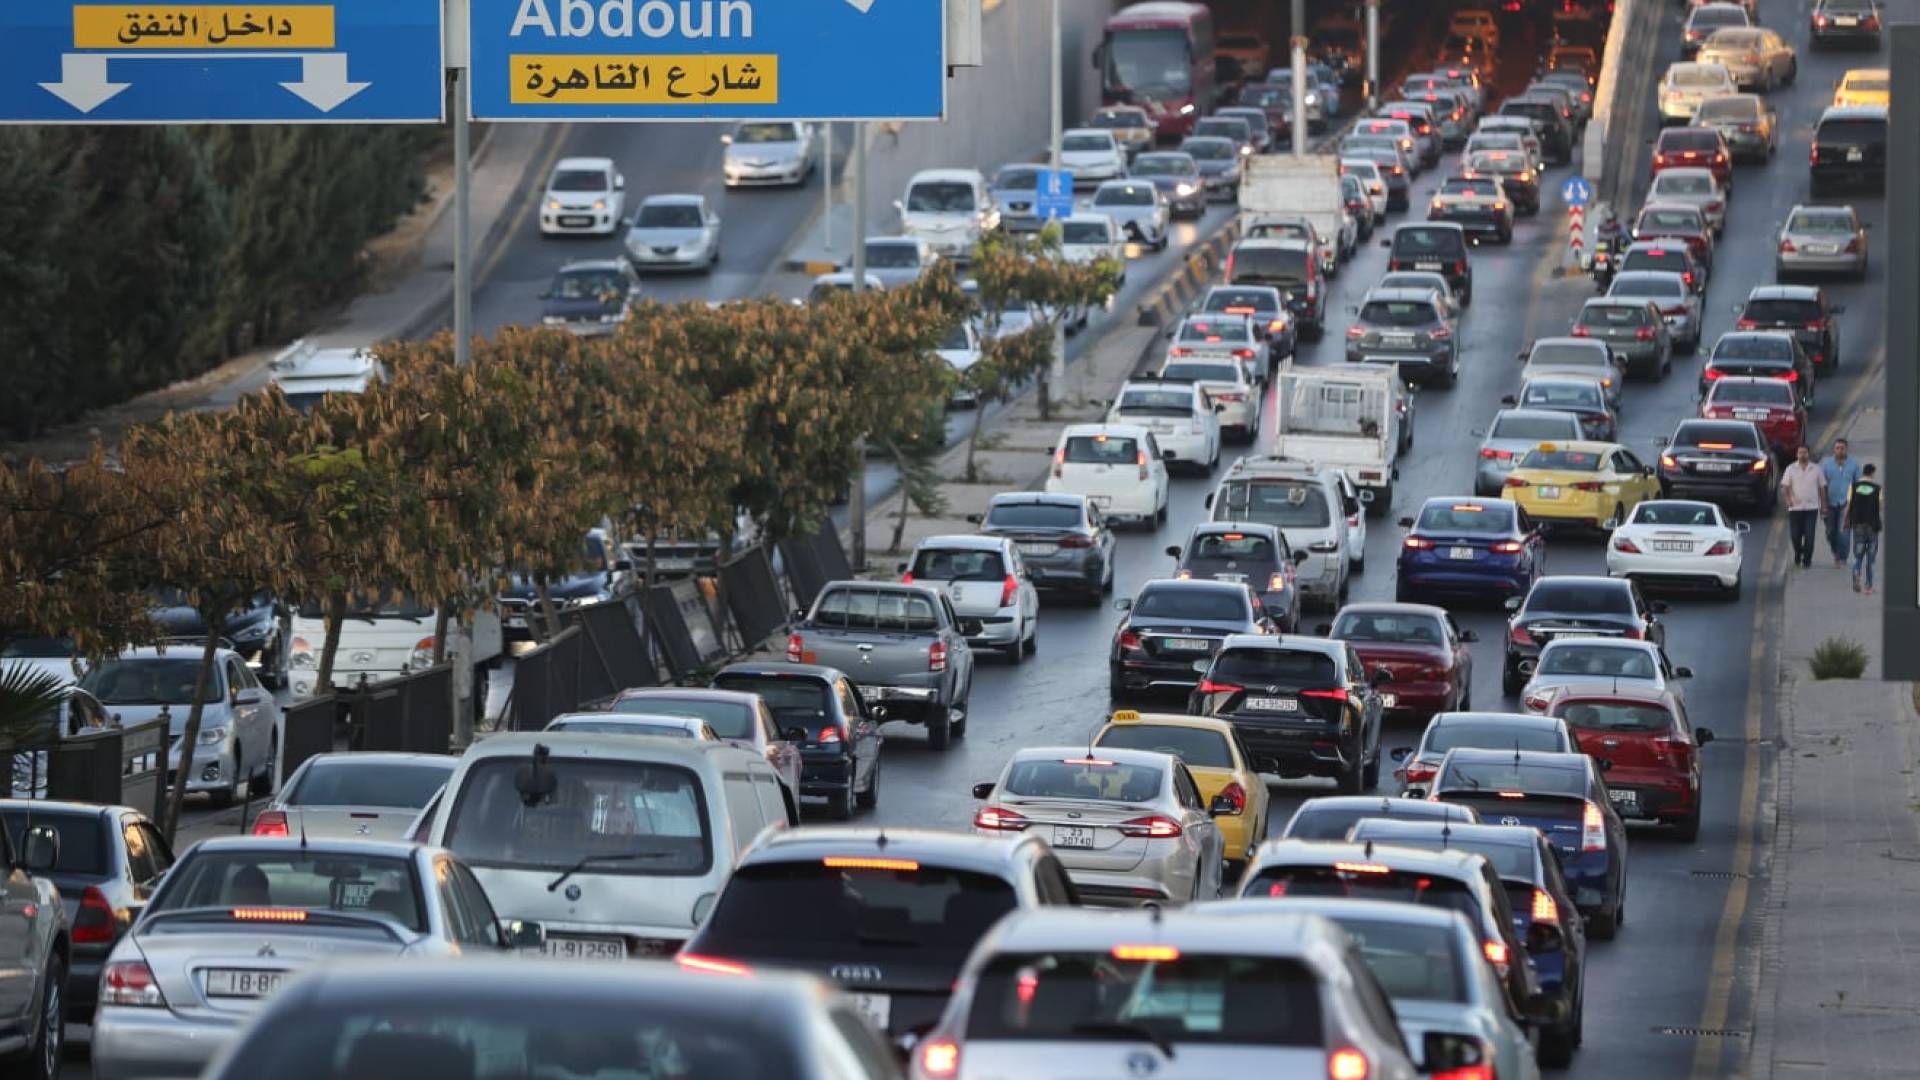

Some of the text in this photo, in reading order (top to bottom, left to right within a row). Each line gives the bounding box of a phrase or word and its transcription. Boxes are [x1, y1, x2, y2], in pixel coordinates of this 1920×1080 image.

[117, 14, 293, 43] داخل النفق
[510, 0, 753, 38] Abdoun
[526, 63, 762, 98] شارع القاهرة
